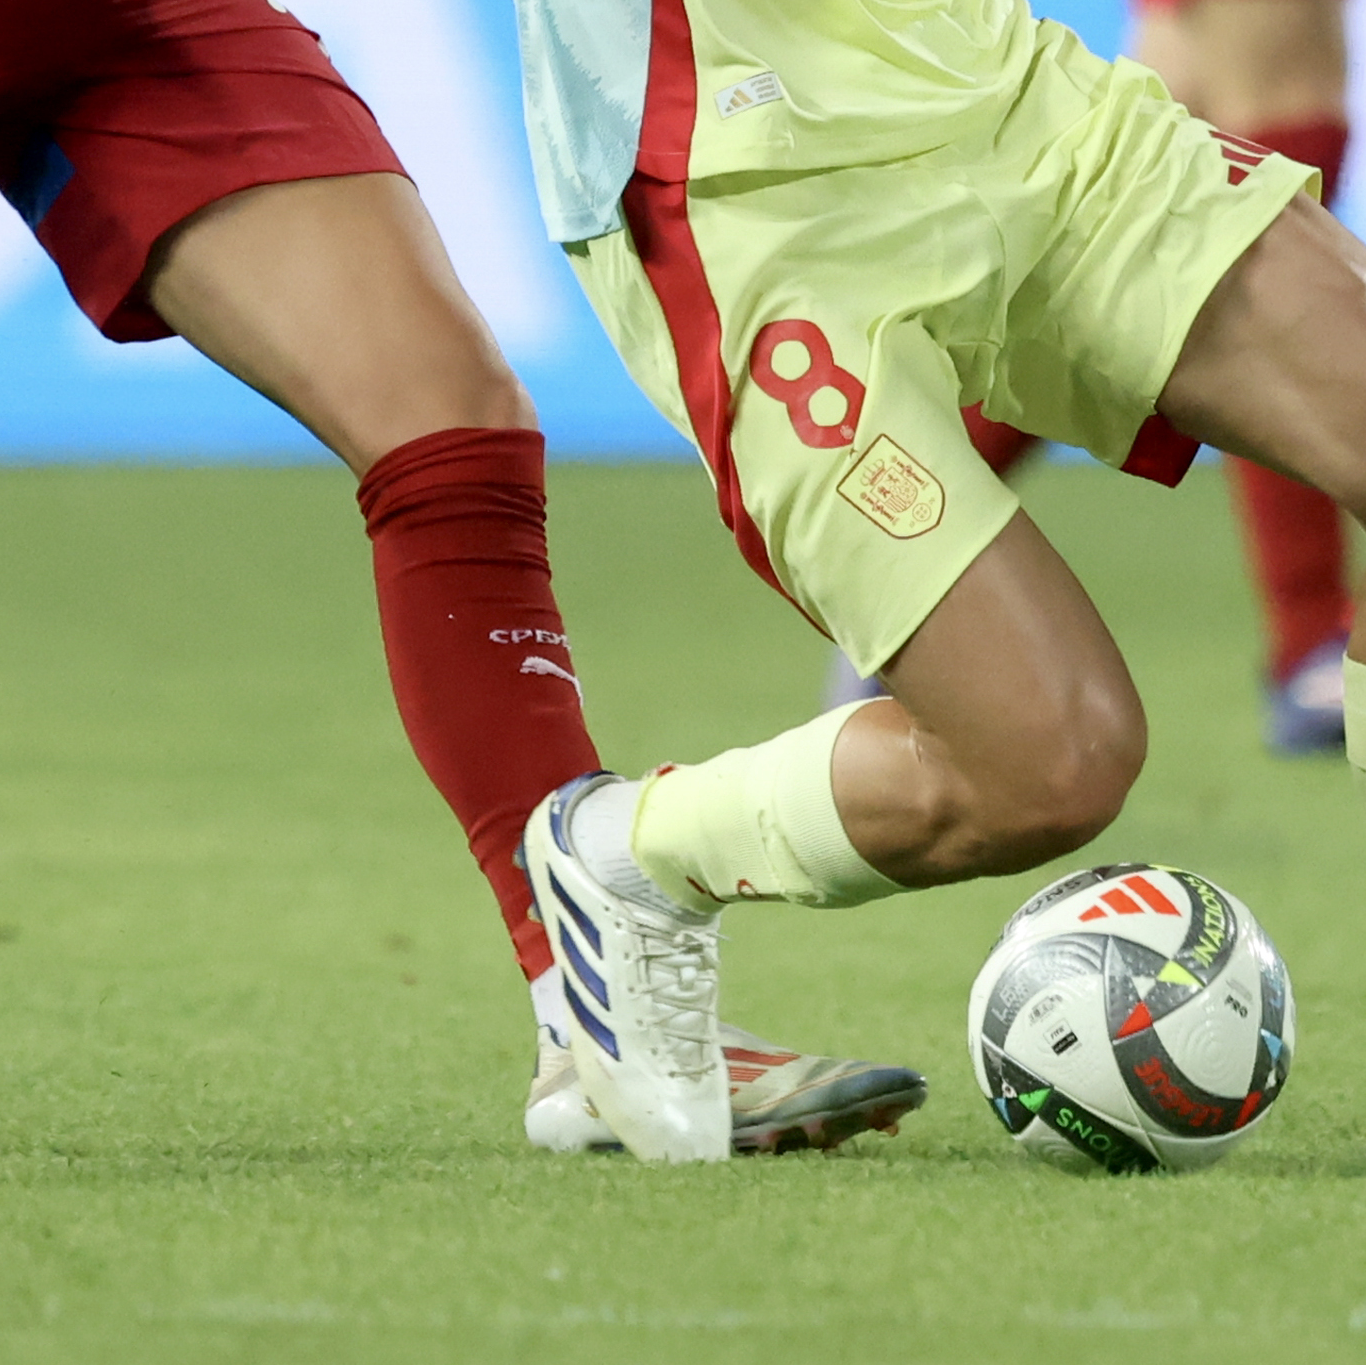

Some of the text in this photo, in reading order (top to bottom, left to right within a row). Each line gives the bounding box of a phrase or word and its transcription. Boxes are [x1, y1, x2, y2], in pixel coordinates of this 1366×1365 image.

[749, 318, 867, 449] 8
[1181, 875, 1225, 969] NATIONS
[1225, 995, 1248, 1018] PRO
[1134, 1057, 1223, 1126] LEAGUE
